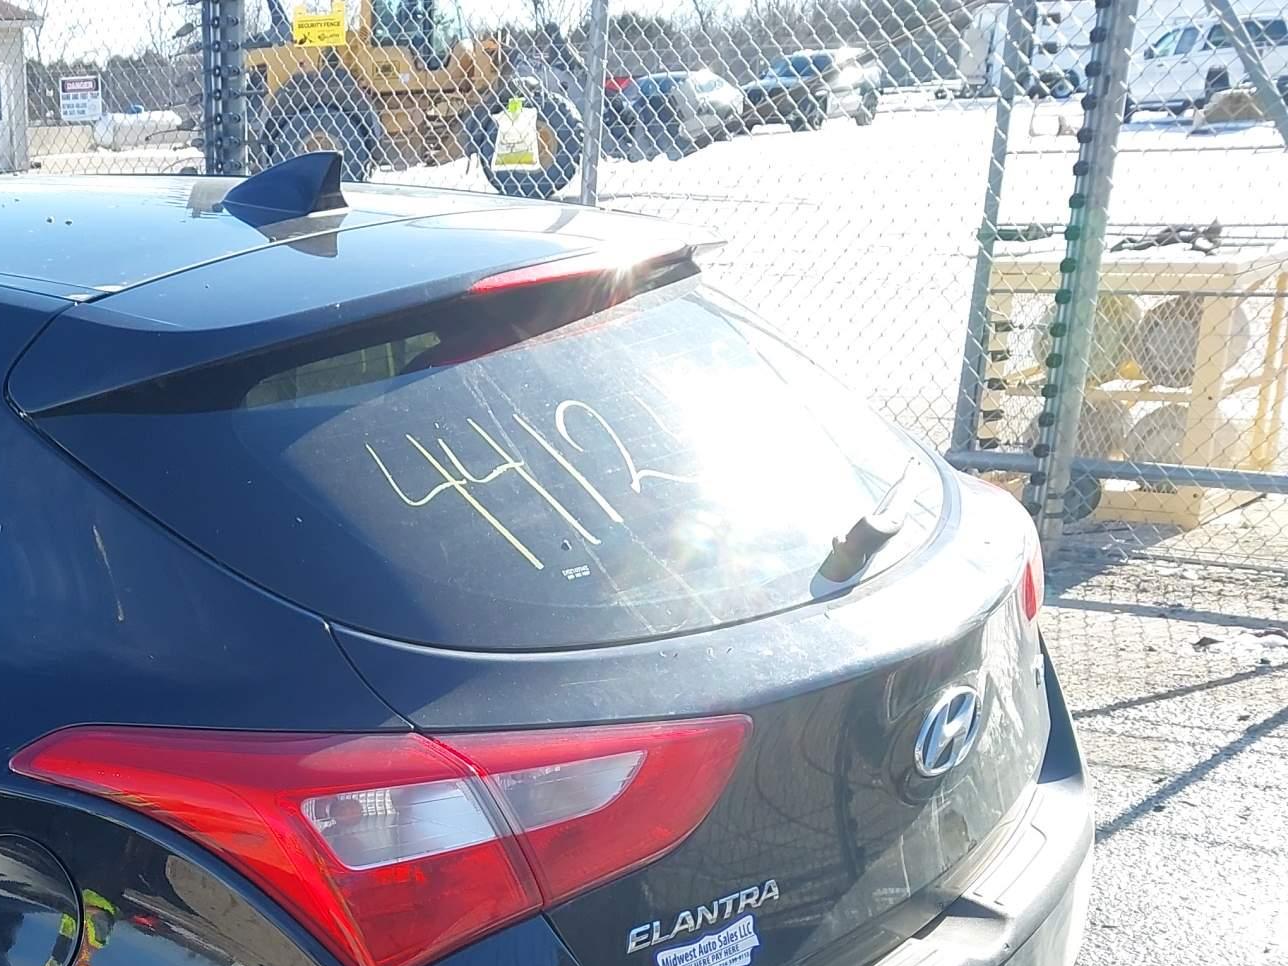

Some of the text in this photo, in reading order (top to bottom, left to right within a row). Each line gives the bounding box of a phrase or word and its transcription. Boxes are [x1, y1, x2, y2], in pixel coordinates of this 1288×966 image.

[627, 879, 780, 954] ELANTRA
[698, 941, 717, 957] Auto
[717, 931, 738, 948] Sales
[738, 922, 752, 938] LLC
[712, 952, 723, 963] PAY
[724, 944, 740, 957] HERE
